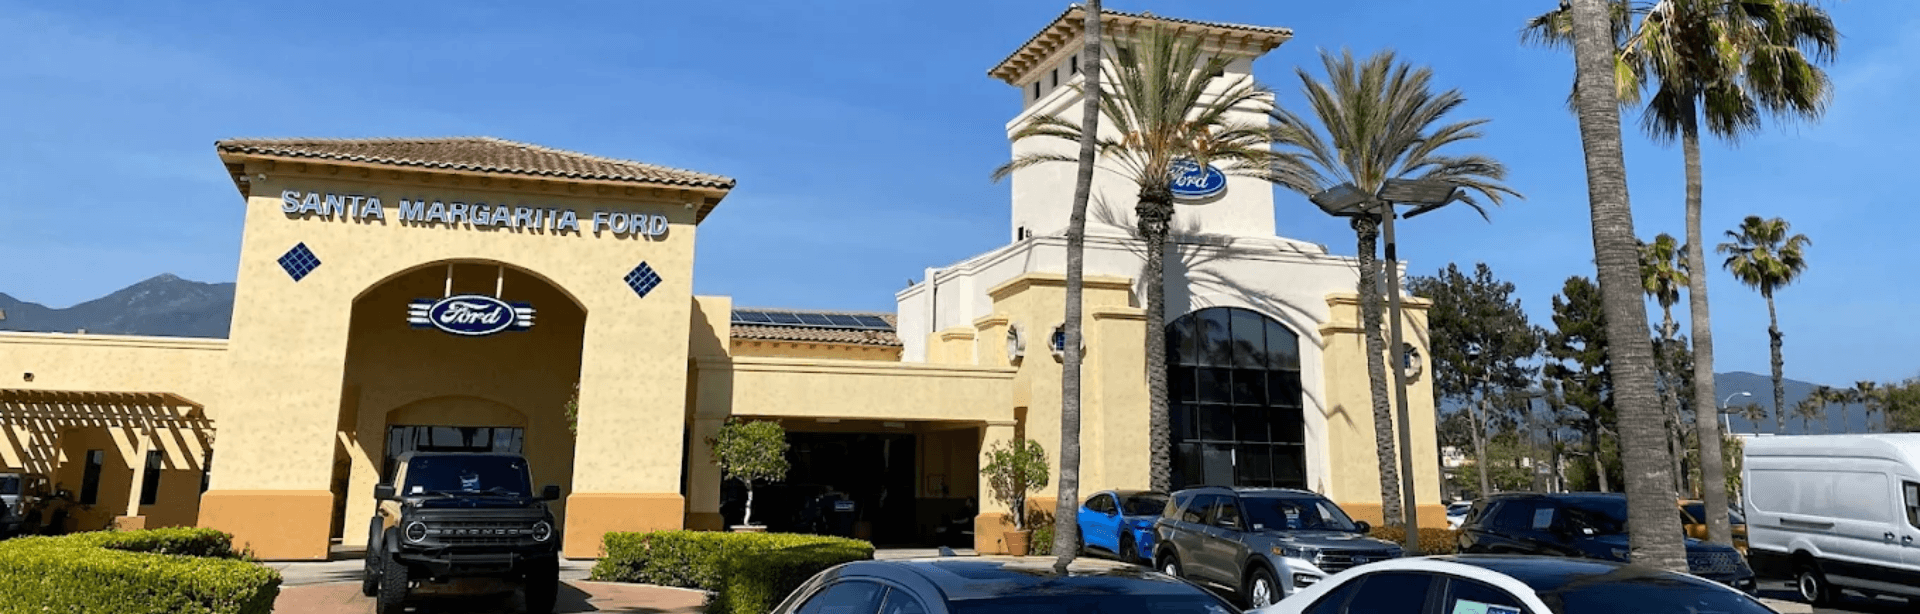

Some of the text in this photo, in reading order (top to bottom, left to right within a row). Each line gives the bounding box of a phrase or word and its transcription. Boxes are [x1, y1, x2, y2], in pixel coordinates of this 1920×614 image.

[281, 190, 669, 236] SANTA MARGARITA FORD
[440, 301, 502, 324] Ford
